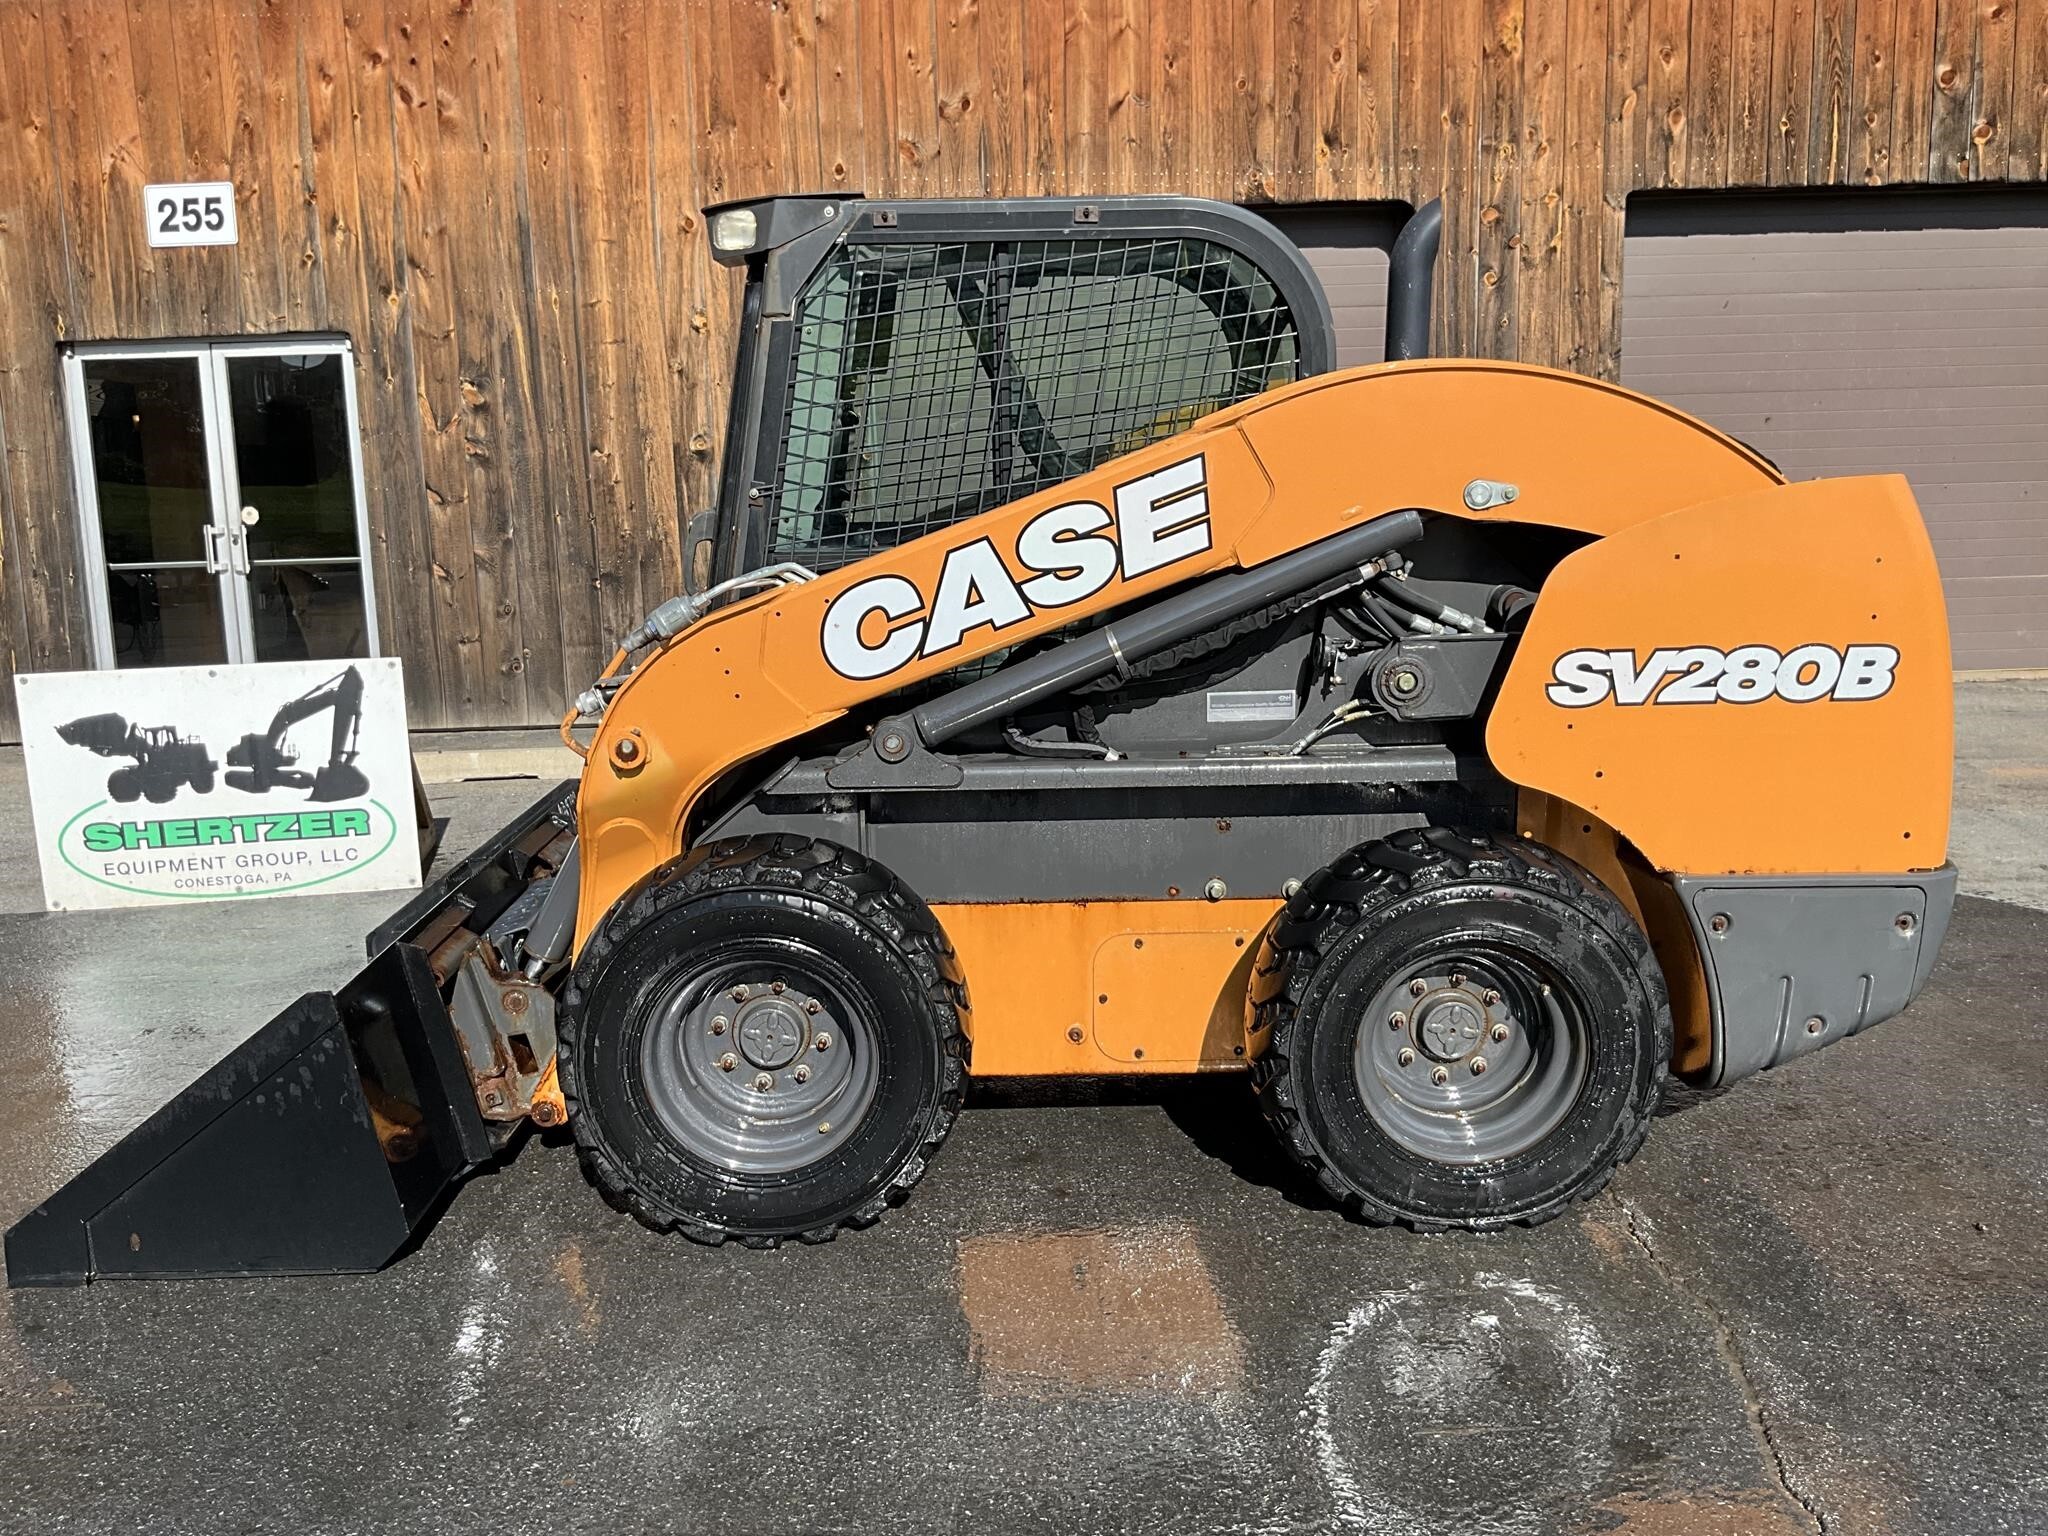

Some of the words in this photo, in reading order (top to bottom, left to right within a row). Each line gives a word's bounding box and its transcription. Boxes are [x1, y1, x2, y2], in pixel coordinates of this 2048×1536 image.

[158, 197, 224, 232] 255
[821, 452, 1212, 680] CASE
[1545, 643, 1900, 708] SV280B
[83, 808, 371, 852] SHERTZER
[104, 856, 226, 876] EQUIPMENT
[235, 851, 312, 868] GROUP,
[321, 848, 359, 863] LLC
[174, 873, 268, 889] CONESTOGA,
[274, 873, 292, 883] PA
